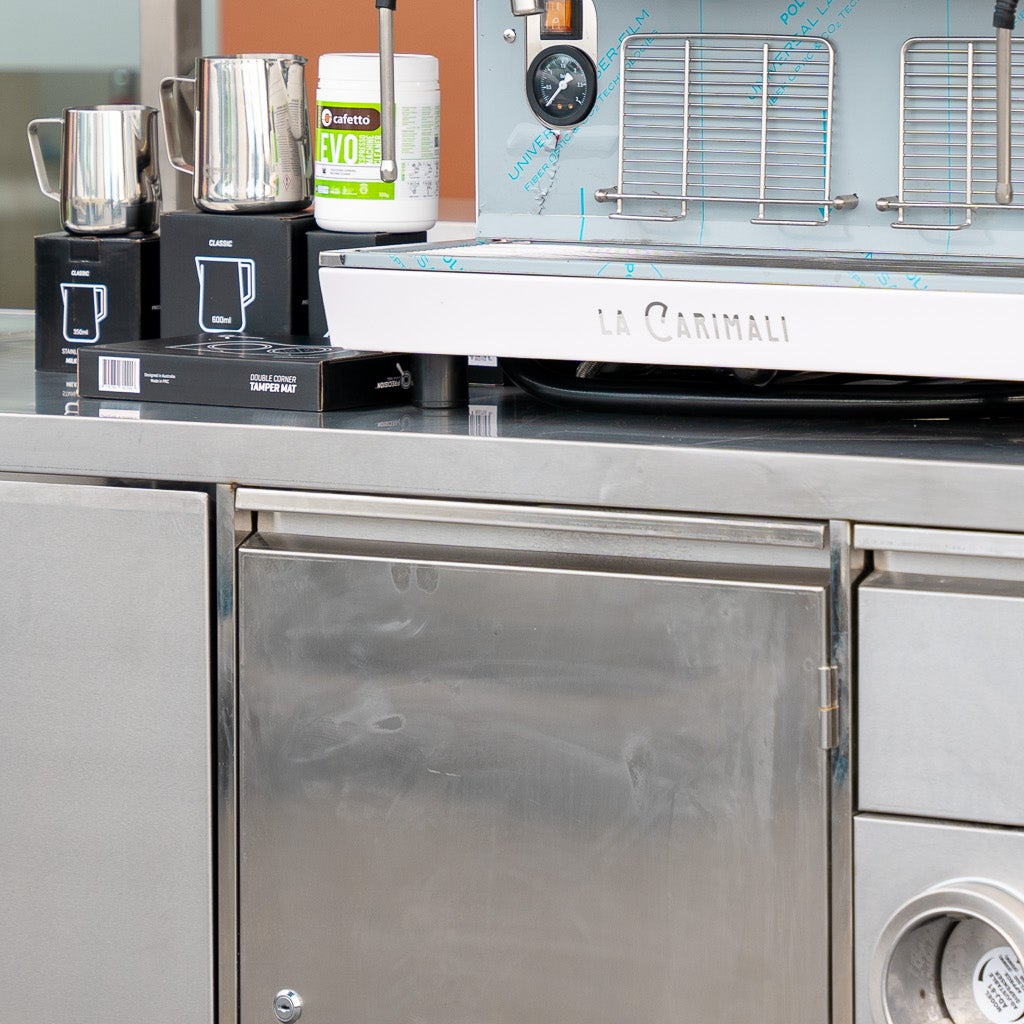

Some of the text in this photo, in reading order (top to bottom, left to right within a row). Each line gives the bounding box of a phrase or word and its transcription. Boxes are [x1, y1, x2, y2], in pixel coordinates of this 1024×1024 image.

[333, 114, 370, 125] cafetto
[320, 133, 358, 165] EVO
[521, 161, 551, 193] FIBER
[208, 239, 233, 248] CLASSIC
[71, 269, 90, 277] CLASSIC
[211, 315, 232, 324] 600ml
[598, 301, 789, 343] LA CARIMALI
[250, 373, 297, 384] DOUBLE CORNER
[249, 382, 297, 394] TAMPER MAT
[989, 972, 1018, 1010] ADJUSTABLE
